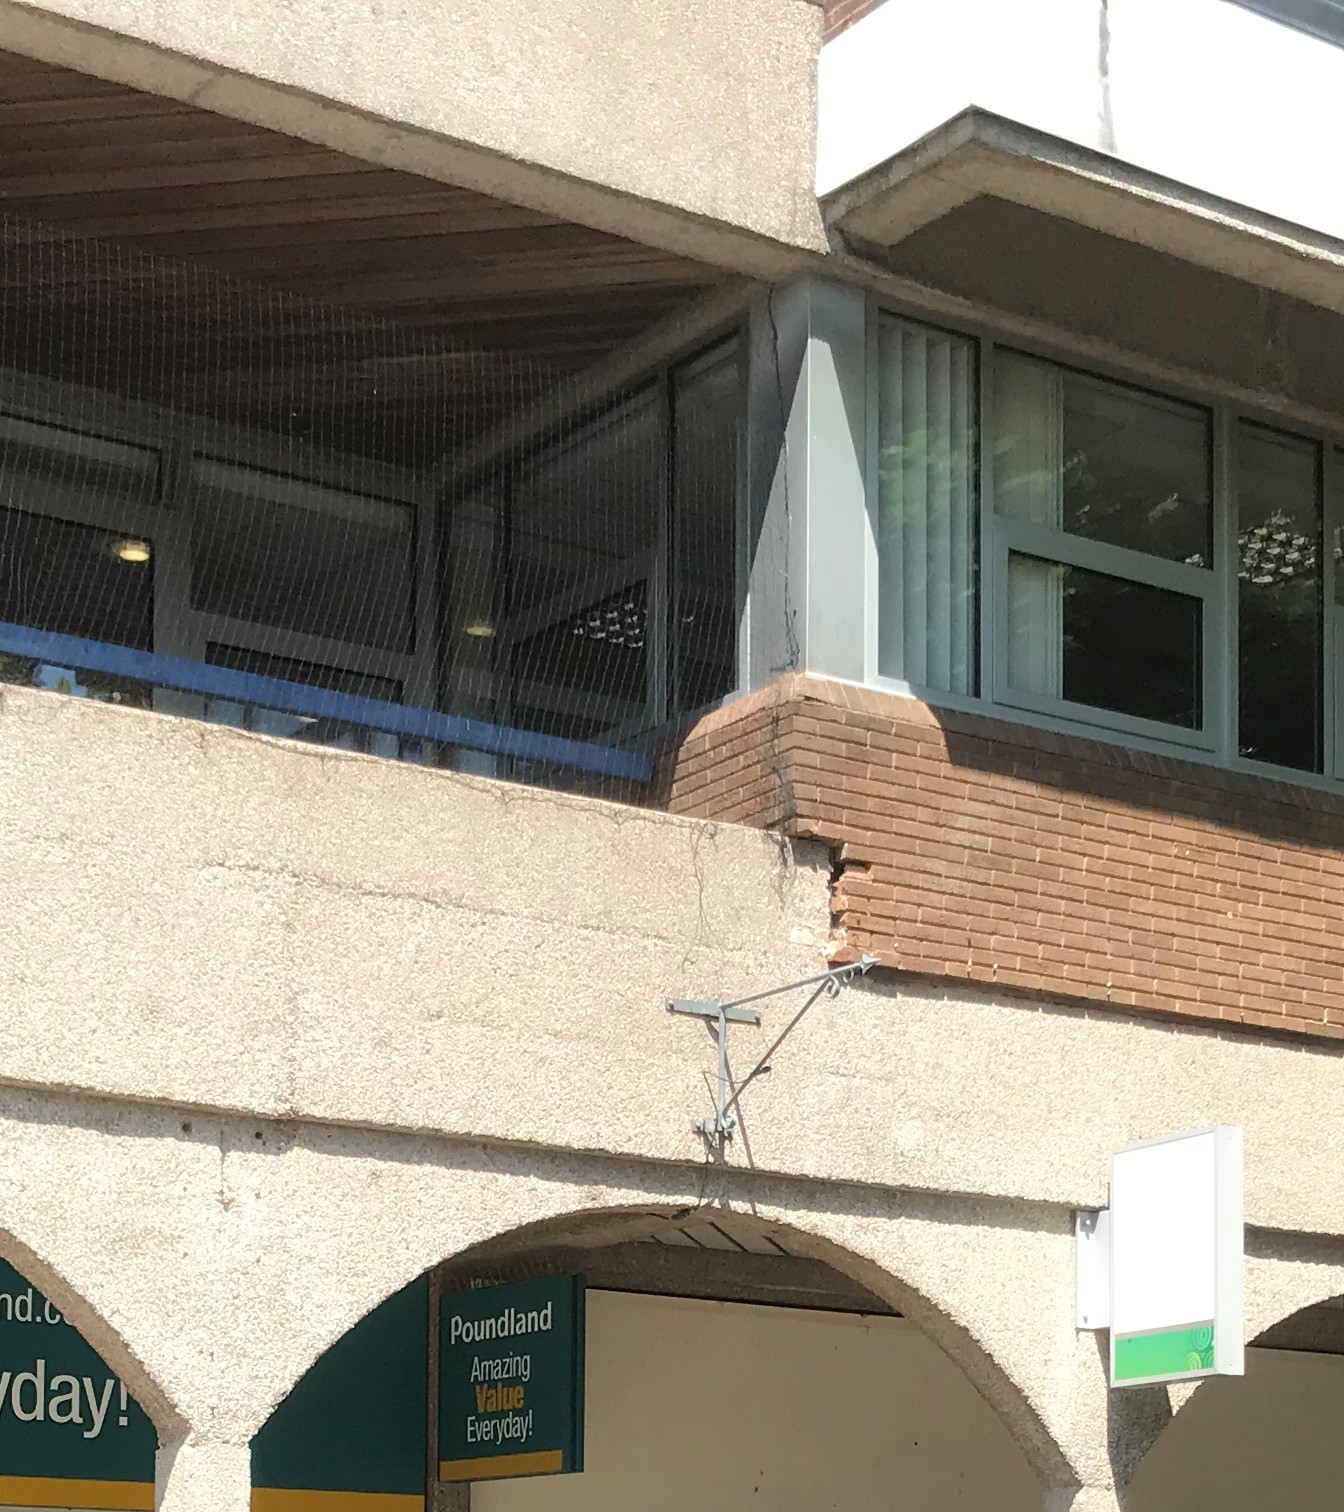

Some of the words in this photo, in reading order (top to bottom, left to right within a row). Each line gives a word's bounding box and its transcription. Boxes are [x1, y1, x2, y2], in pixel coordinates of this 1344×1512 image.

[450, 1301, 552, 1345] Poundland
[470, 1351, 531, 1382] Amazing
[475, 1382, 525, 1414] Value
[467, 1409, 533, 1445] Everyday!
